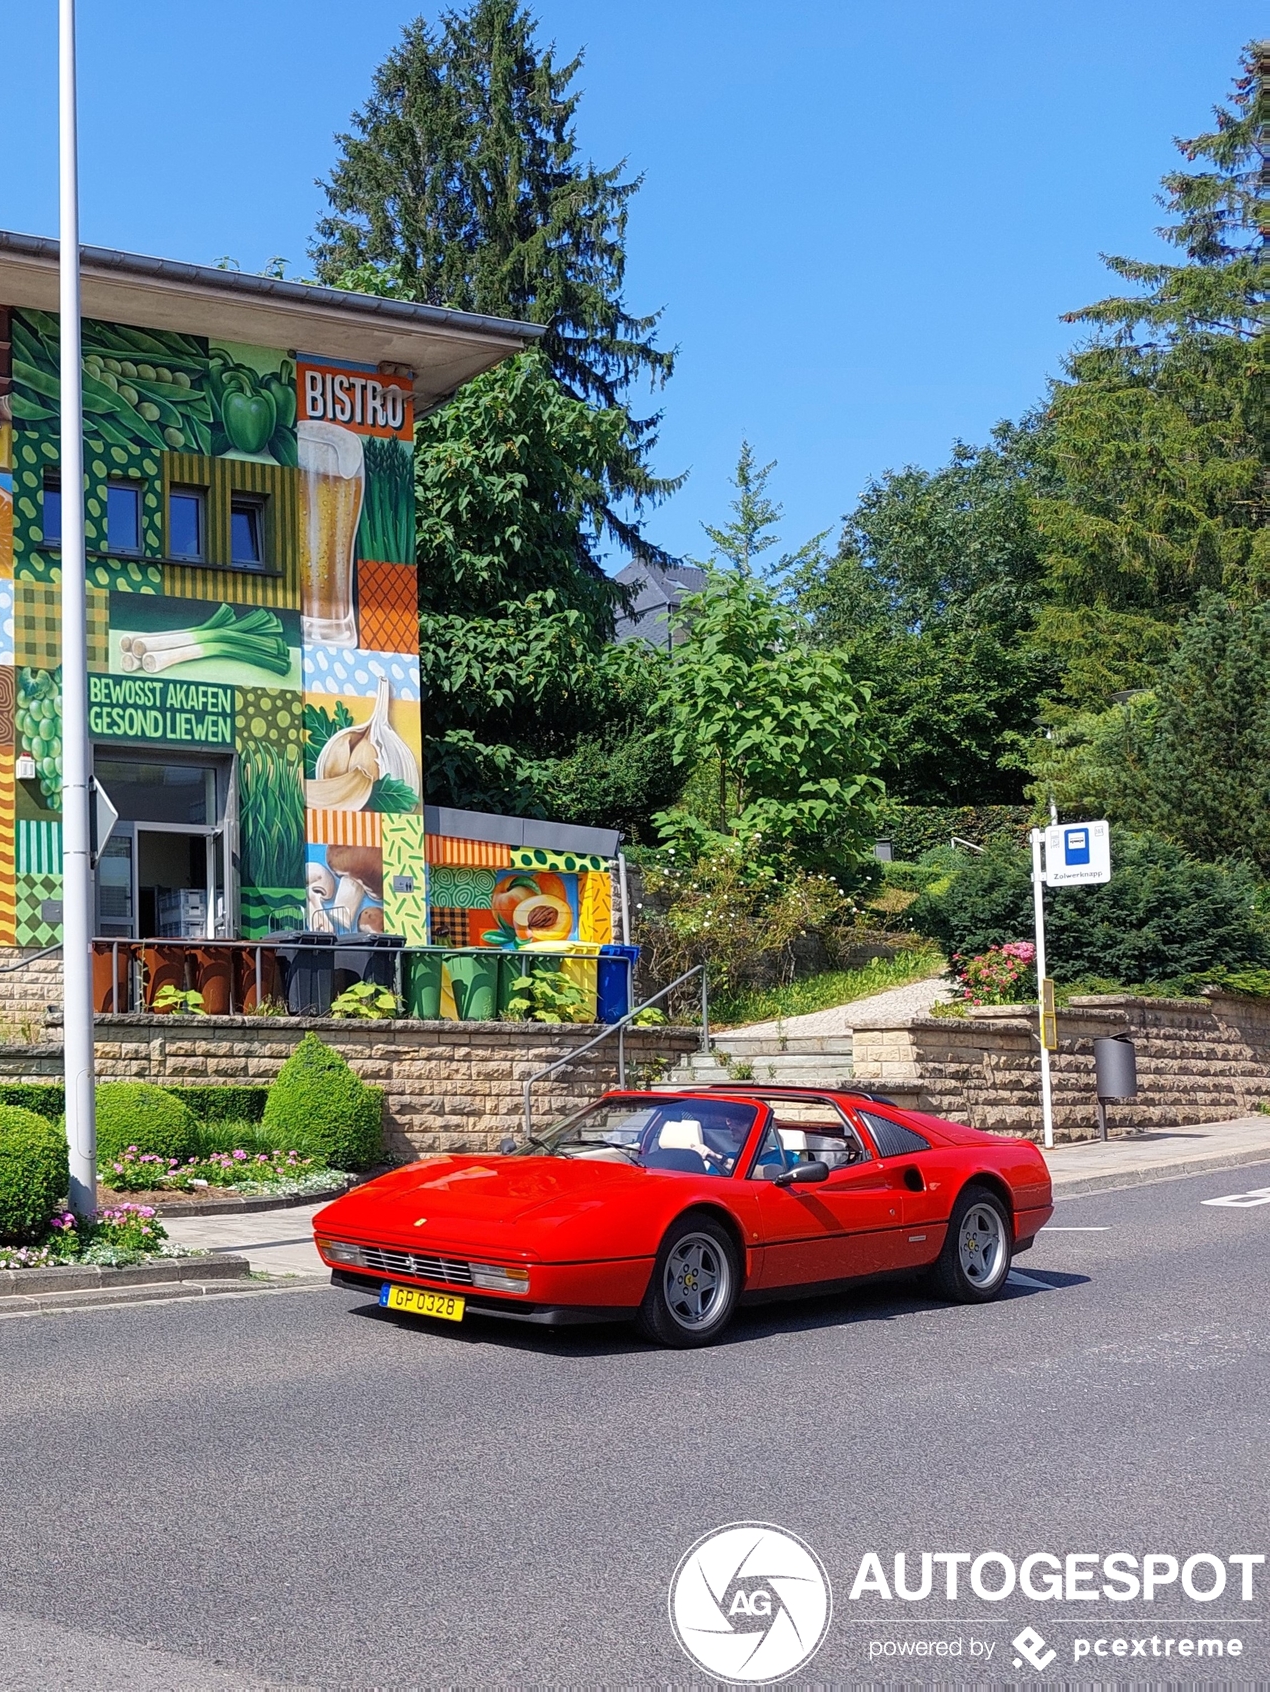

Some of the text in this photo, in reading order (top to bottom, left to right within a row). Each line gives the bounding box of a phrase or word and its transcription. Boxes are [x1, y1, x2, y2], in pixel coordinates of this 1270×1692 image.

[305, 370, 404, 429] BISTRO
[90, 677, 231, 713] BEWOSST AKAFEN
[90, 706, 231, 743] GESOND LIEWEN
[396, 1289, 456, 1315] GP 0328
